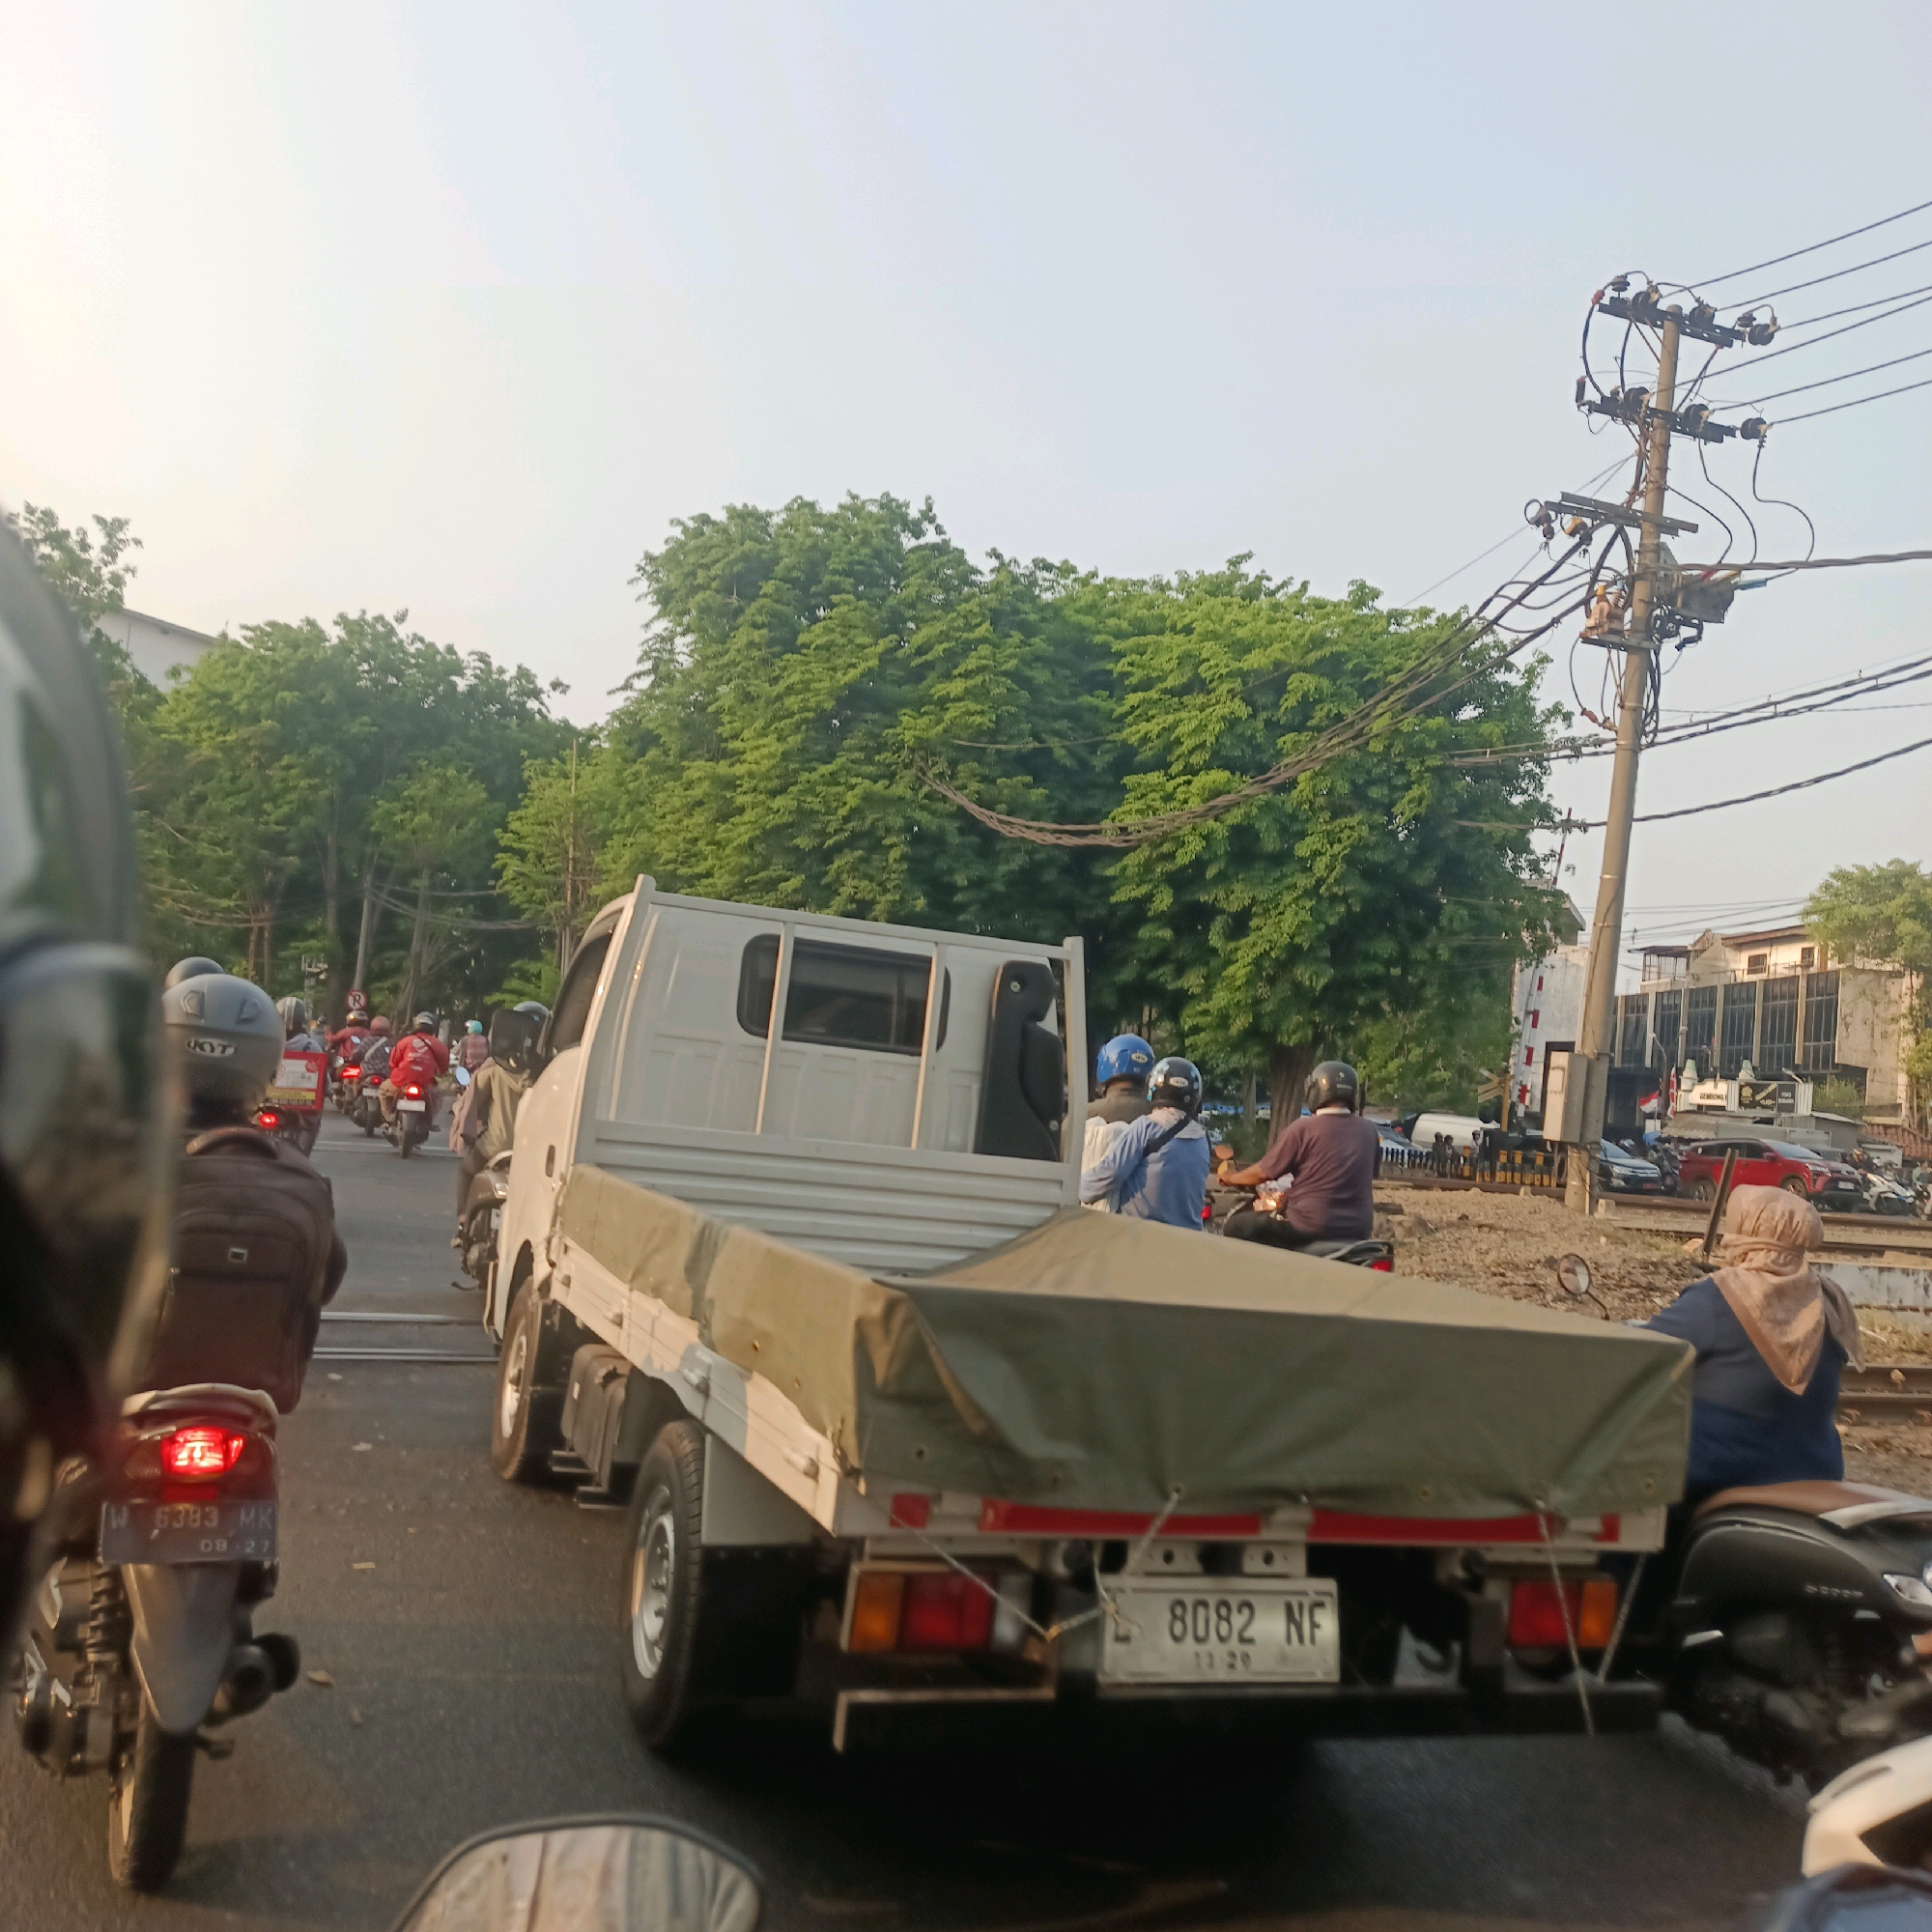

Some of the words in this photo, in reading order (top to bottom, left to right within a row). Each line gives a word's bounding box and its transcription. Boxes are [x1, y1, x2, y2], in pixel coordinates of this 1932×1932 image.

[186, 1038, 236, 1055] KYT
[111, 1505, 129, 1529] W
[156, 1506, 219, 1529] 6383
[240, 1507, 272, 1530] MK
[1168, 1599, 1256, 1643] 8082
[1284, 1600, 1325, 1646] NF
